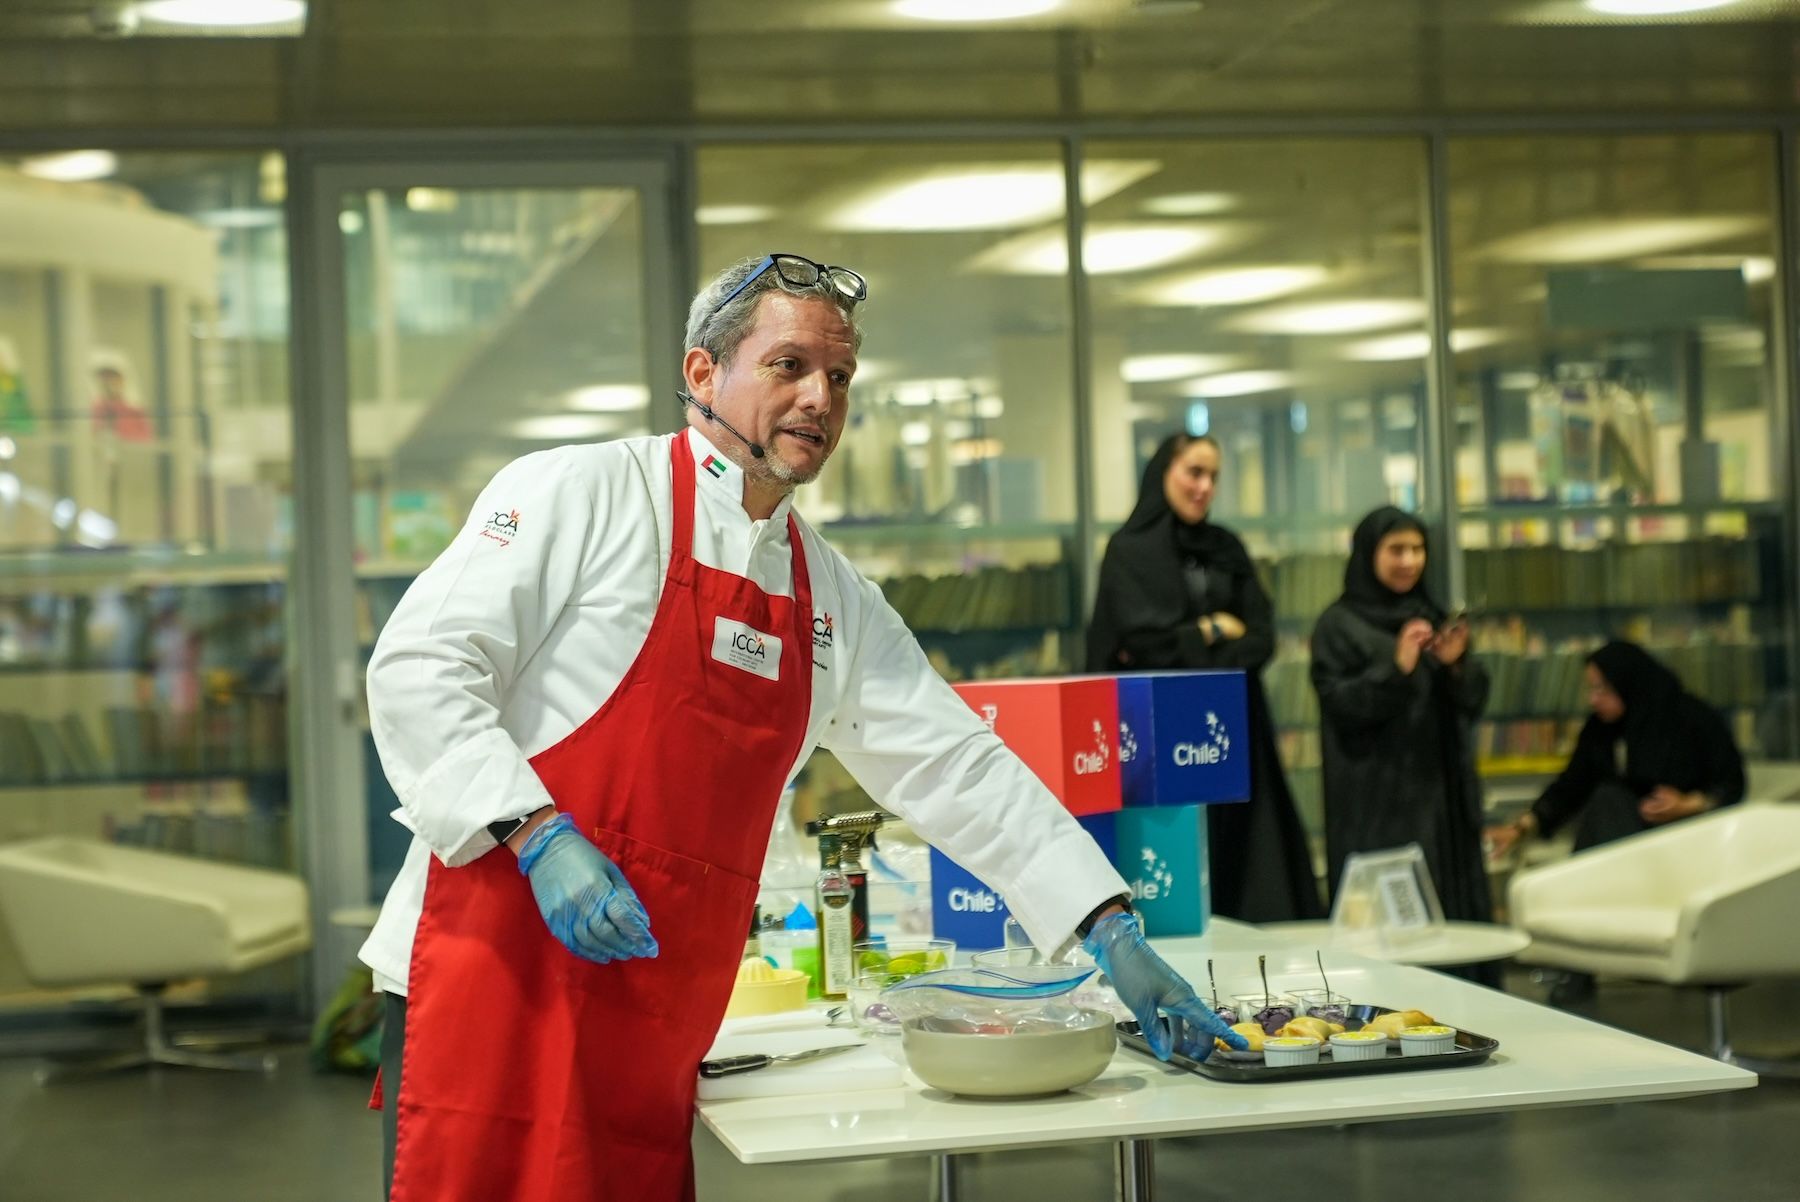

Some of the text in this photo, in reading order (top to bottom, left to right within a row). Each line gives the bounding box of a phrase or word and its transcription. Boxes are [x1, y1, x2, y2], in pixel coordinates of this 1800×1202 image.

[731, 631, 766, 659] ICCA
[1073, 751, 1104, 775] Chile
[1173, 743, 1220, 767] Chile
[948, 886, 996, 913] Chile
